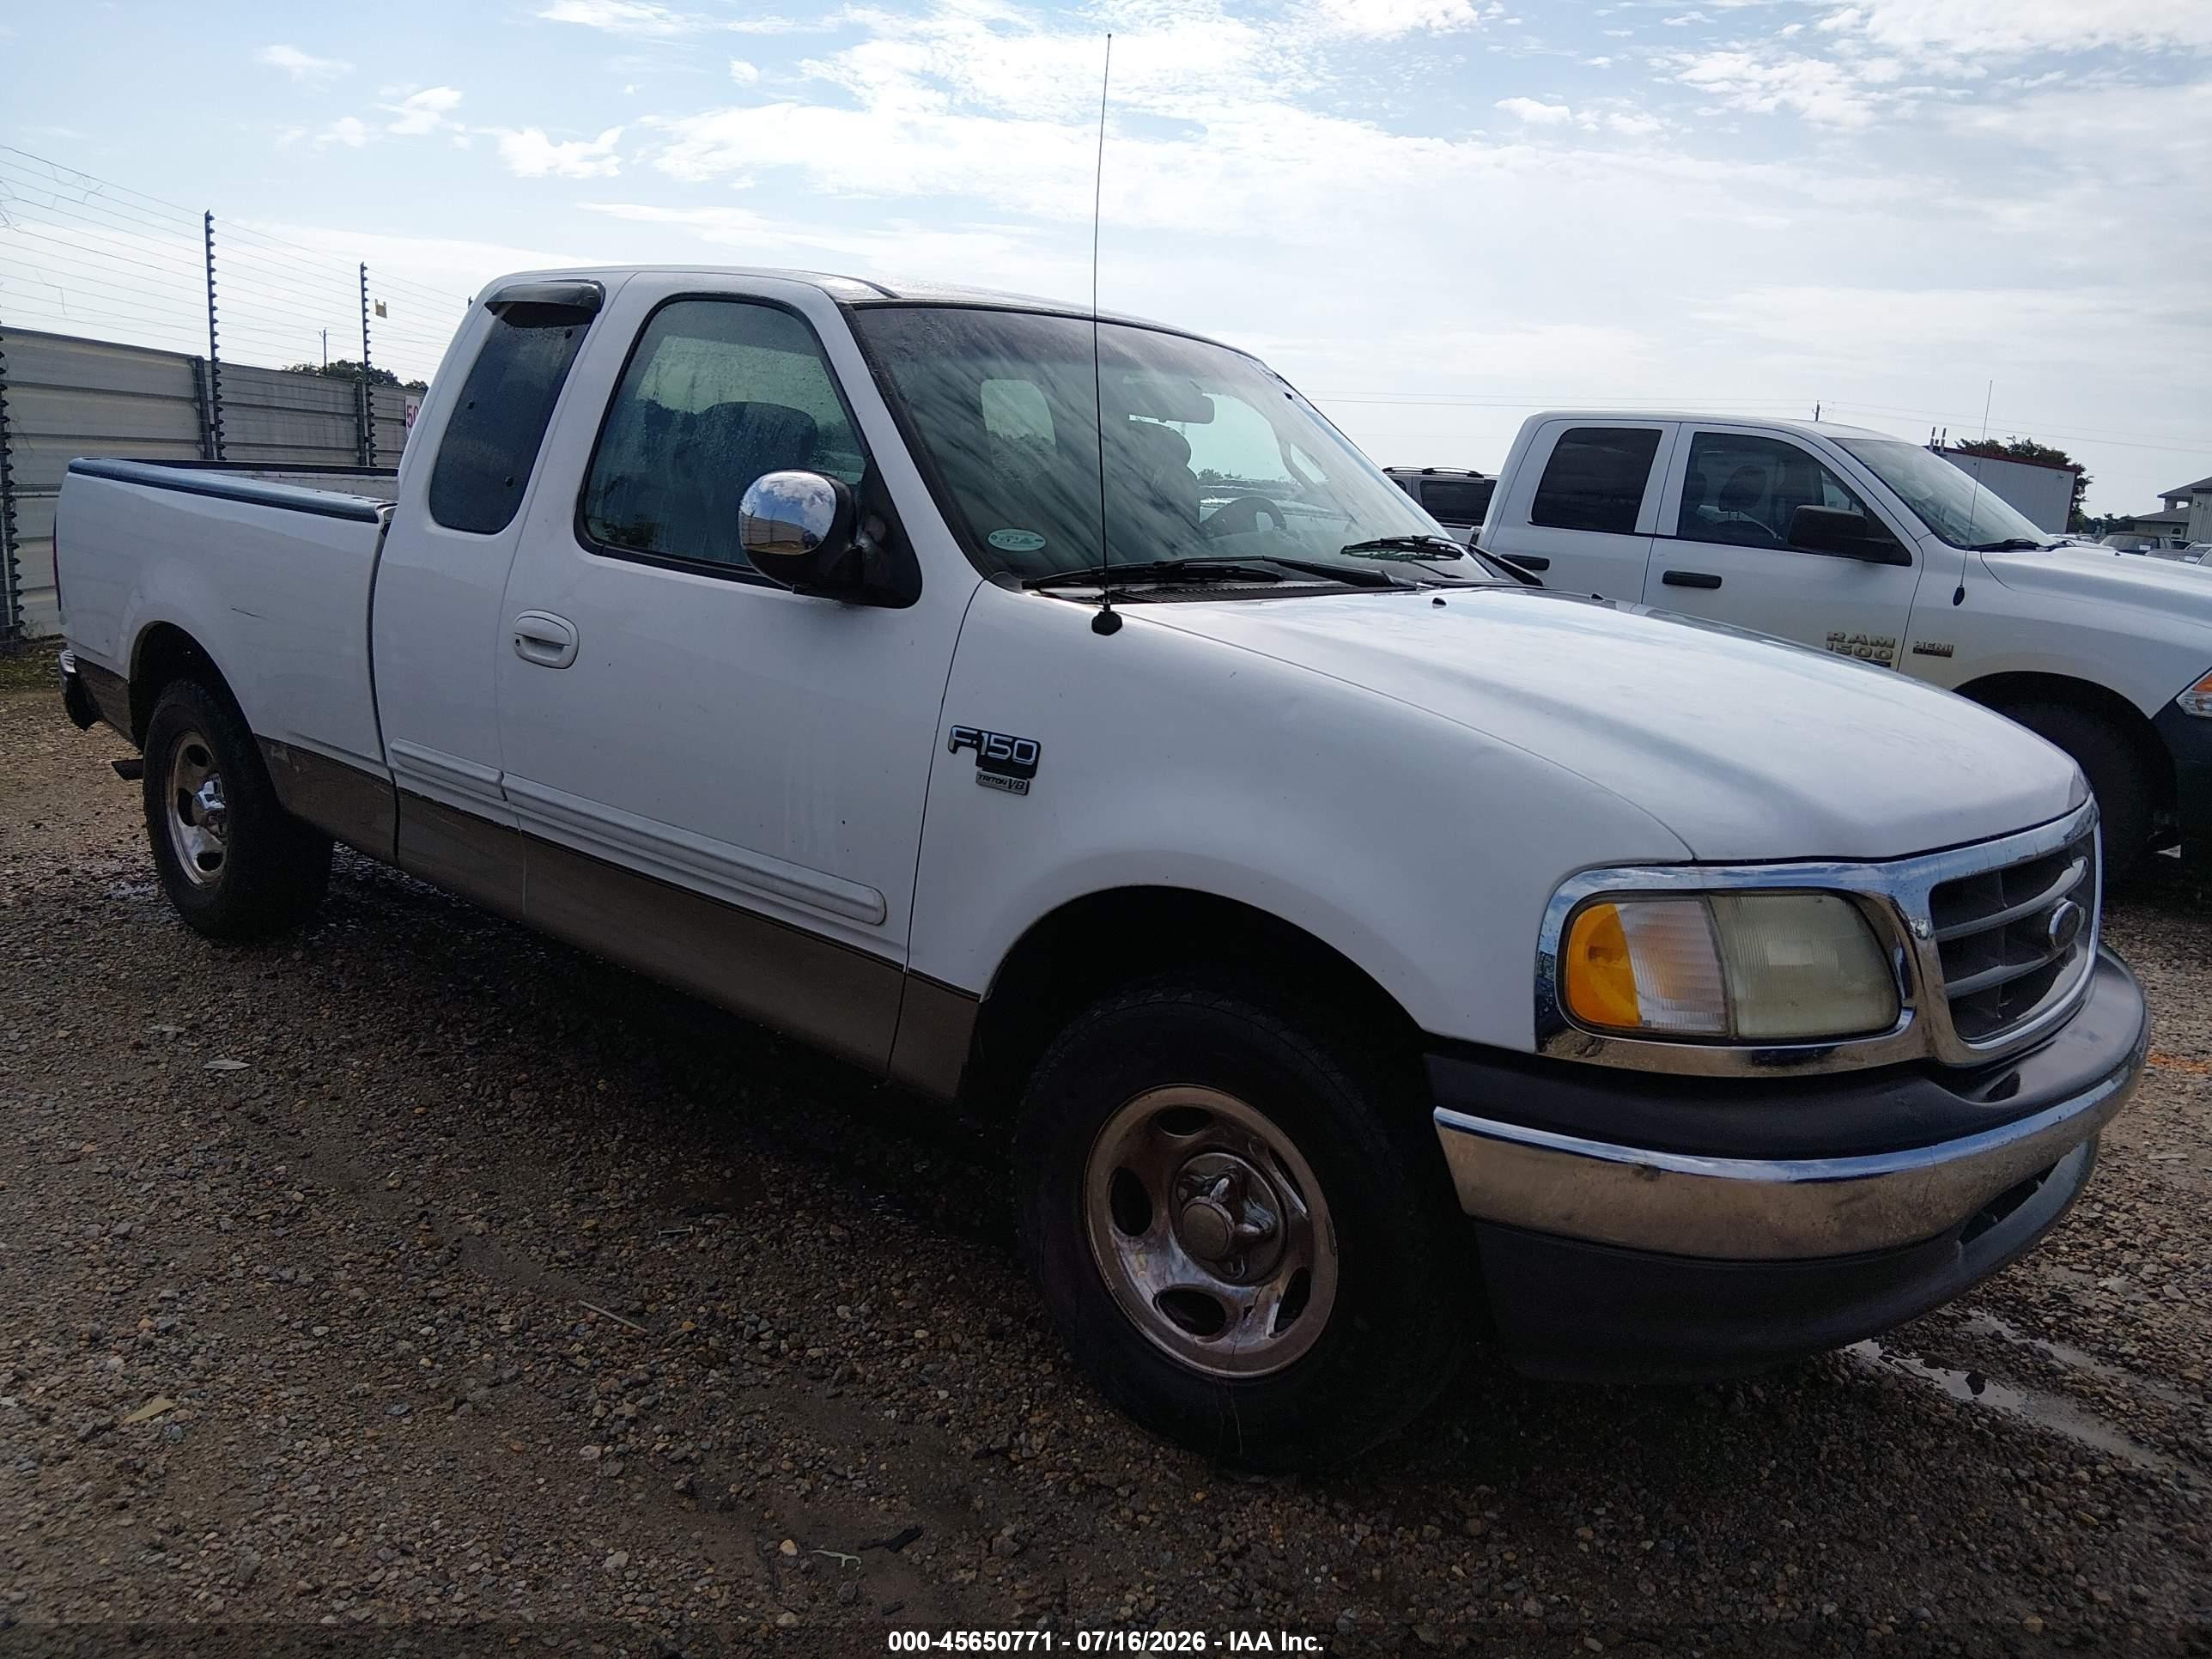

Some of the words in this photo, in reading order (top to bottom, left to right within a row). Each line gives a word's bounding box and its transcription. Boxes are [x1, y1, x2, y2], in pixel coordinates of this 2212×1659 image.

[1826, 632, 1896, 648] RAM
[1914, 640, 1954, 652] HEMI
[1826, 642, 1893, 660] 1500
[978, 775, 1008, 785] TRITON
[1008, 778, 1025, 790] V8
